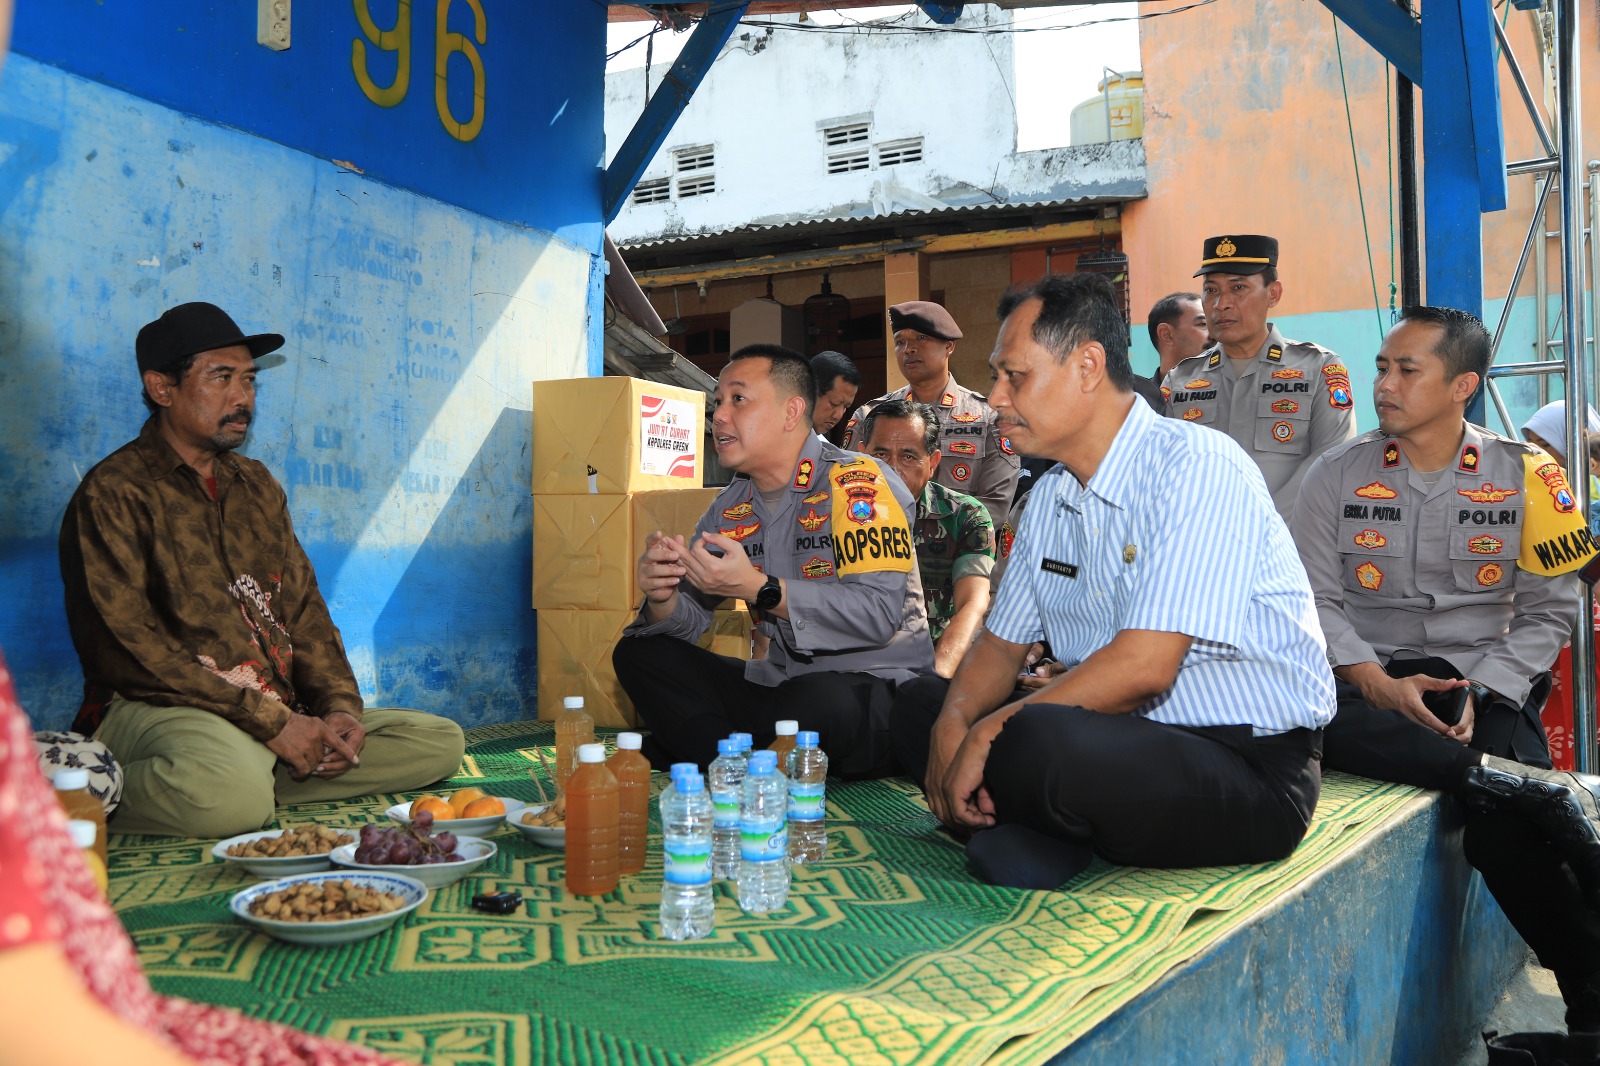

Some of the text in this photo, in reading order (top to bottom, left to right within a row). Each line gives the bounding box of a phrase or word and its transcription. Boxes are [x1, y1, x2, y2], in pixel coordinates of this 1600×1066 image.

[352, 0, 487, 142] 96
[1262, 383, 1309, 393] POLRI
[1173, 390, 1217, 403] ALI FAUZI
[945, 426, 983, 436] POLRI
[1344, 504, 1401, 521] ERIKA PUTRA
[1459, 510, 1516, 524] POLRI
